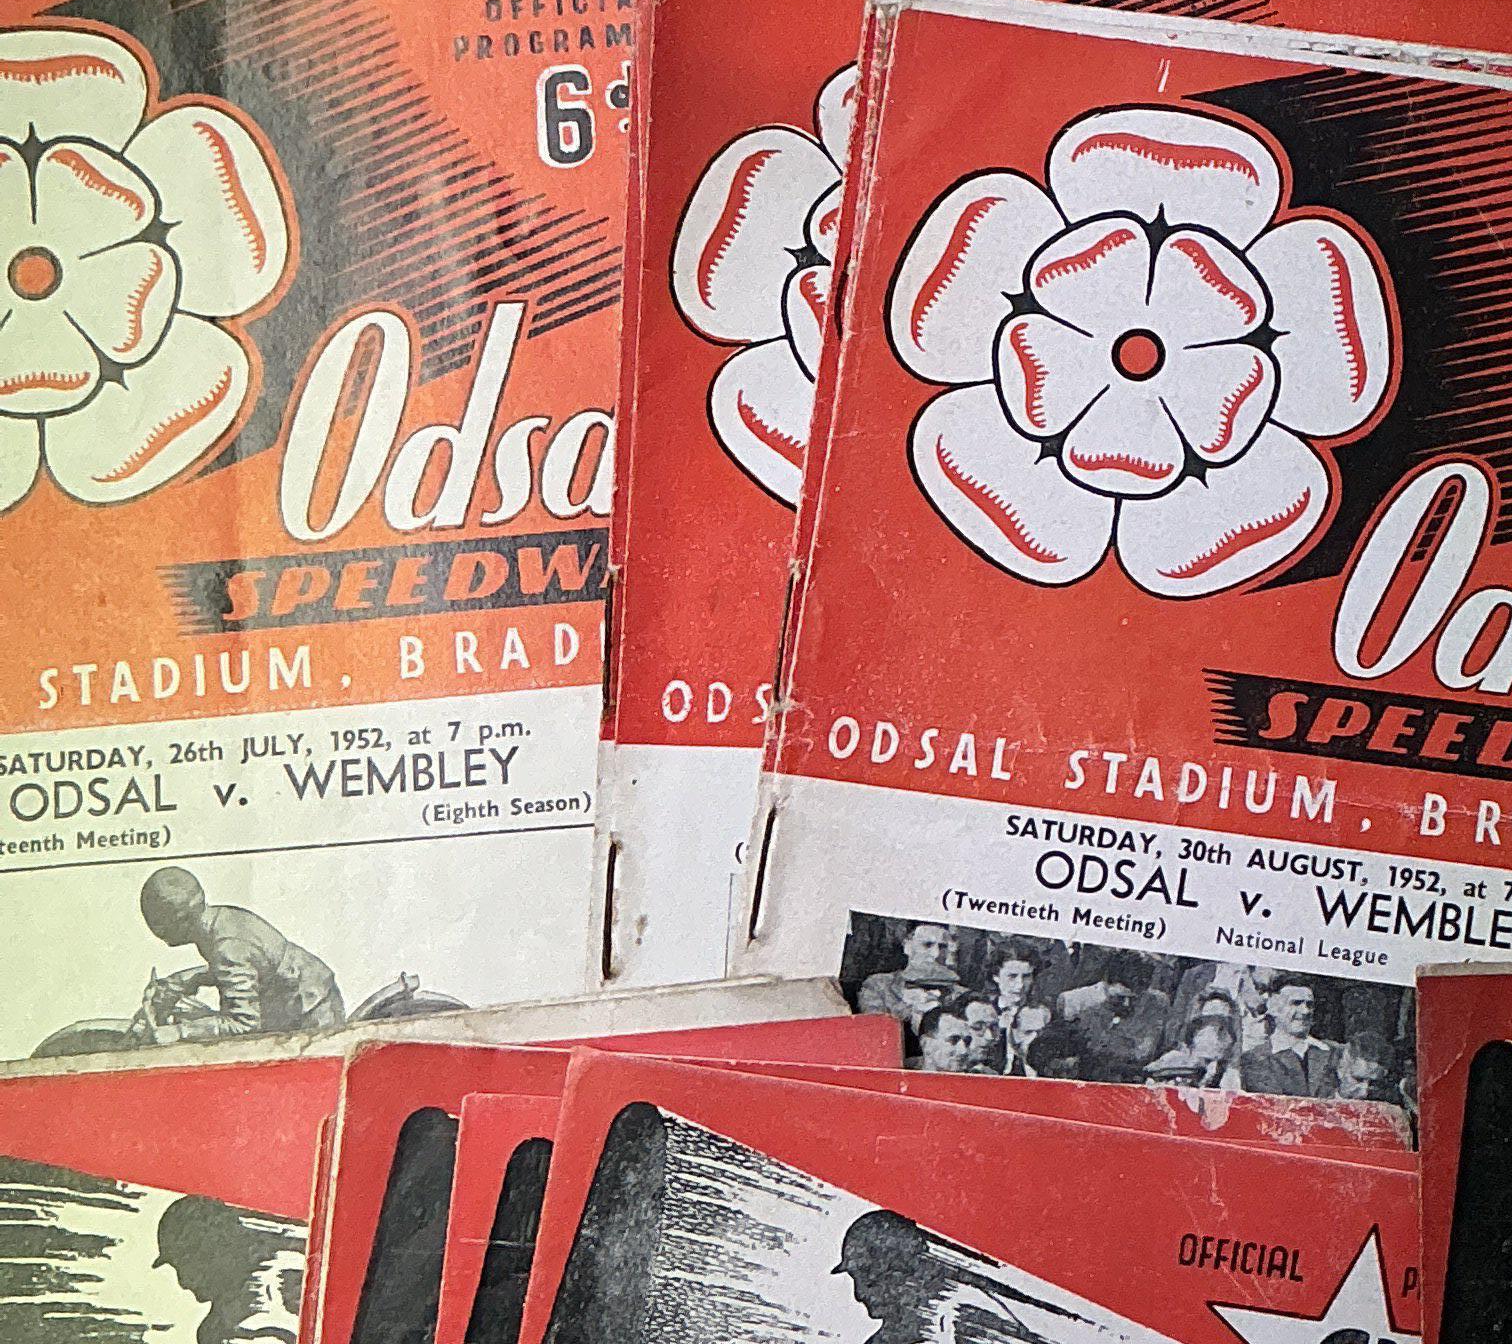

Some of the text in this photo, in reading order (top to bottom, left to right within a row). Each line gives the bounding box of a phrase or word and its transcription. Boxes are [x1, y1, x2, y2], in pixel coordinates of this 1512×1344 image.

[168, 719, 532, 765] 26th JULY, 1952, p.m.
[828, 716, 1012, 781] ODSAL
[9, 745, 521, 823] ODSAL WEMBLEY
[421, 790, 592, 825] (Eighth Season)
[76, 825, 172, 848] Meeting)
[1006, 814, 1163, 859] SATURDAY,
[1178, 839, 1232, 866] 30th
[1247, 847, 1369, 886] AUGUST,
[1388, 865, 1446, 896] 1952,
[1035, 850, 1199, 908] ODSAL
[941, 888, 1167, 940] (Twentieth Meeting)
[1216, 926, 1389, 966] National League
[1177, 1232, 1304, 1283] OFFICIAL
